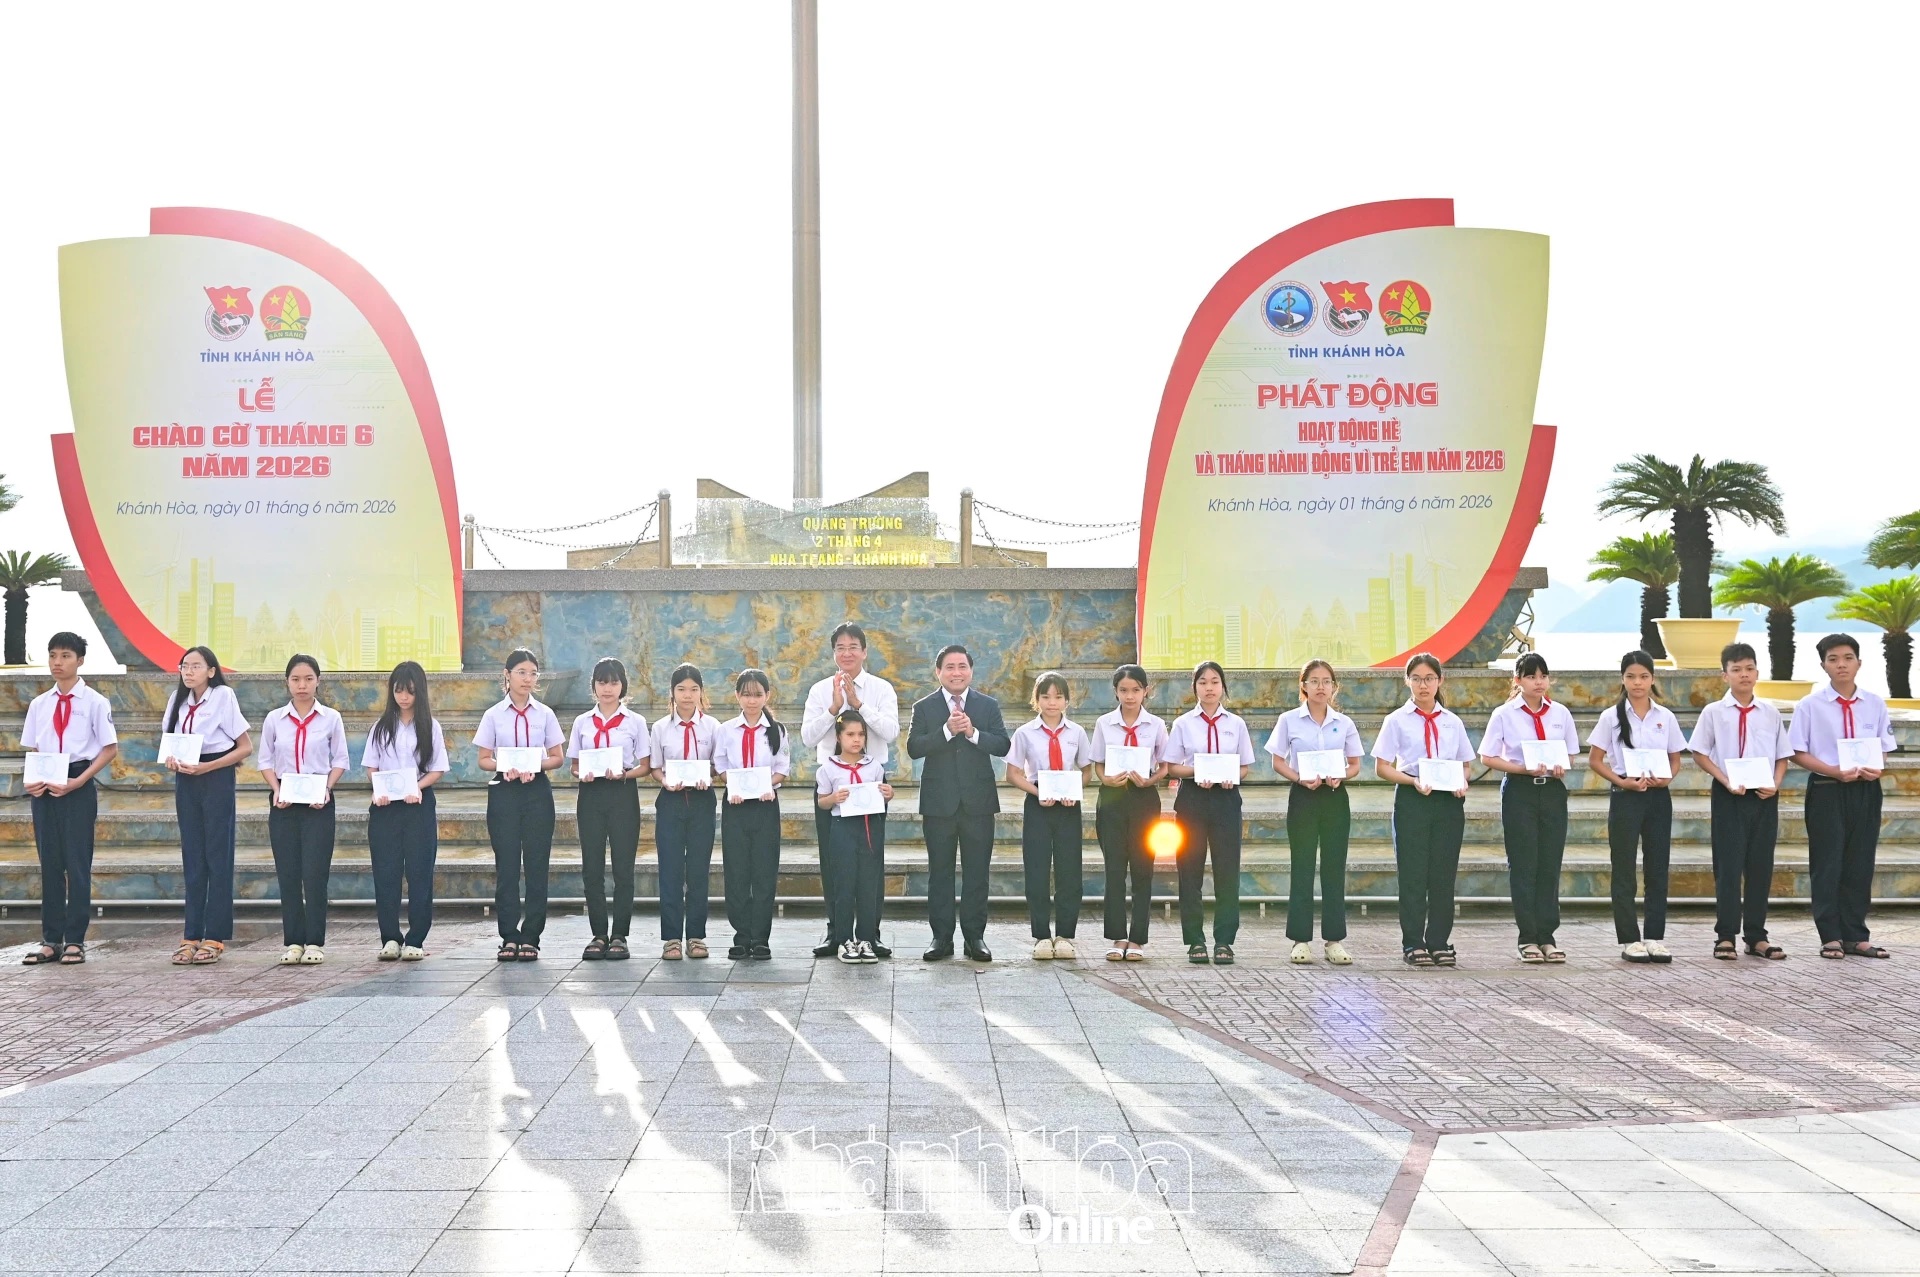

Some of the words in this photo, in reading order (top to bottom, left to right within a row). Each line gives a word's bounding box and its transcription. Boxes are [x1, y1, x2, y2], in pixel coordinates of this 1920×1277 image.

[200, 349, 229, 363] TỈNH
[234, 350, 280, 362] KHÁNH
[285, 348, 314, 362] HÒA
[1288, 344, 1318, 358] TỈNH
[1323, 345, 1370, 358] KHÁNH
[1375, 345, 1405, 357] HÒA
[238, 376, 276, 412] LỄ
[1257, 378, 1341, 409] PHÁT
[1346, 377, 1439, 413] ĐỘNG
[132, 422, 205, 447] CHÀO
[212, 422, 251, 447] CỜ
[255, 421, 347, 447] THÁNG
[354, 424, 375, 446] 6
[1298, 420, 1335, 447] HOẠT
[1338, 418, 1379, 447] ĐỘNG
[1381, 417, 1402, 443] HÈ
[182, 453, 249, 478] NĂM
[256, 456, 332, 478] 2026
[1195, 450, 1216, 476] VÀ
[1217, 450, 1266, 475] THÁNG
[1267, 450, 1309, 475] HÀNH
[1311, 449, 1352, 479] ĐỘNG
[1354, 449, 1371, 474] VÌ
[1372, 446, 1399, 473] TRẺ
[1401, 451, 1424, 473] EM
[1426, 447, 1463, 473] NĂM
[1465, 450, 1506, 472] 2026
[116, 501, 162, 515] Khánh
[166, 501, 198, 515] Hòa,
[203, 500, 242, 517] ngày
[244, 500, 260, 514] 01
[266, 500, 309, 517] tháng
[312, 500, 322, 513] 6
[325, 500, 359, 514] năm
[362, 499, 396, 514] 2026
[1208, 498, 1255, 512] Khánh
[1259, 498, 1292, 512] Hòa,
[1297, 496, 1336, 514] ngày
[1340, 496, 1355, 511] 01
[1361, 496, 1405, 513] tháng
[1408, 496, 1418, 510] 6
[1421, 496, 1455, 509] năm
[1459, 494, 1493, 509] 2026
[816, 535, 824, 548] 2
[874, 534, 882, 548] 4
[770, 553, 796, 566] NHA
